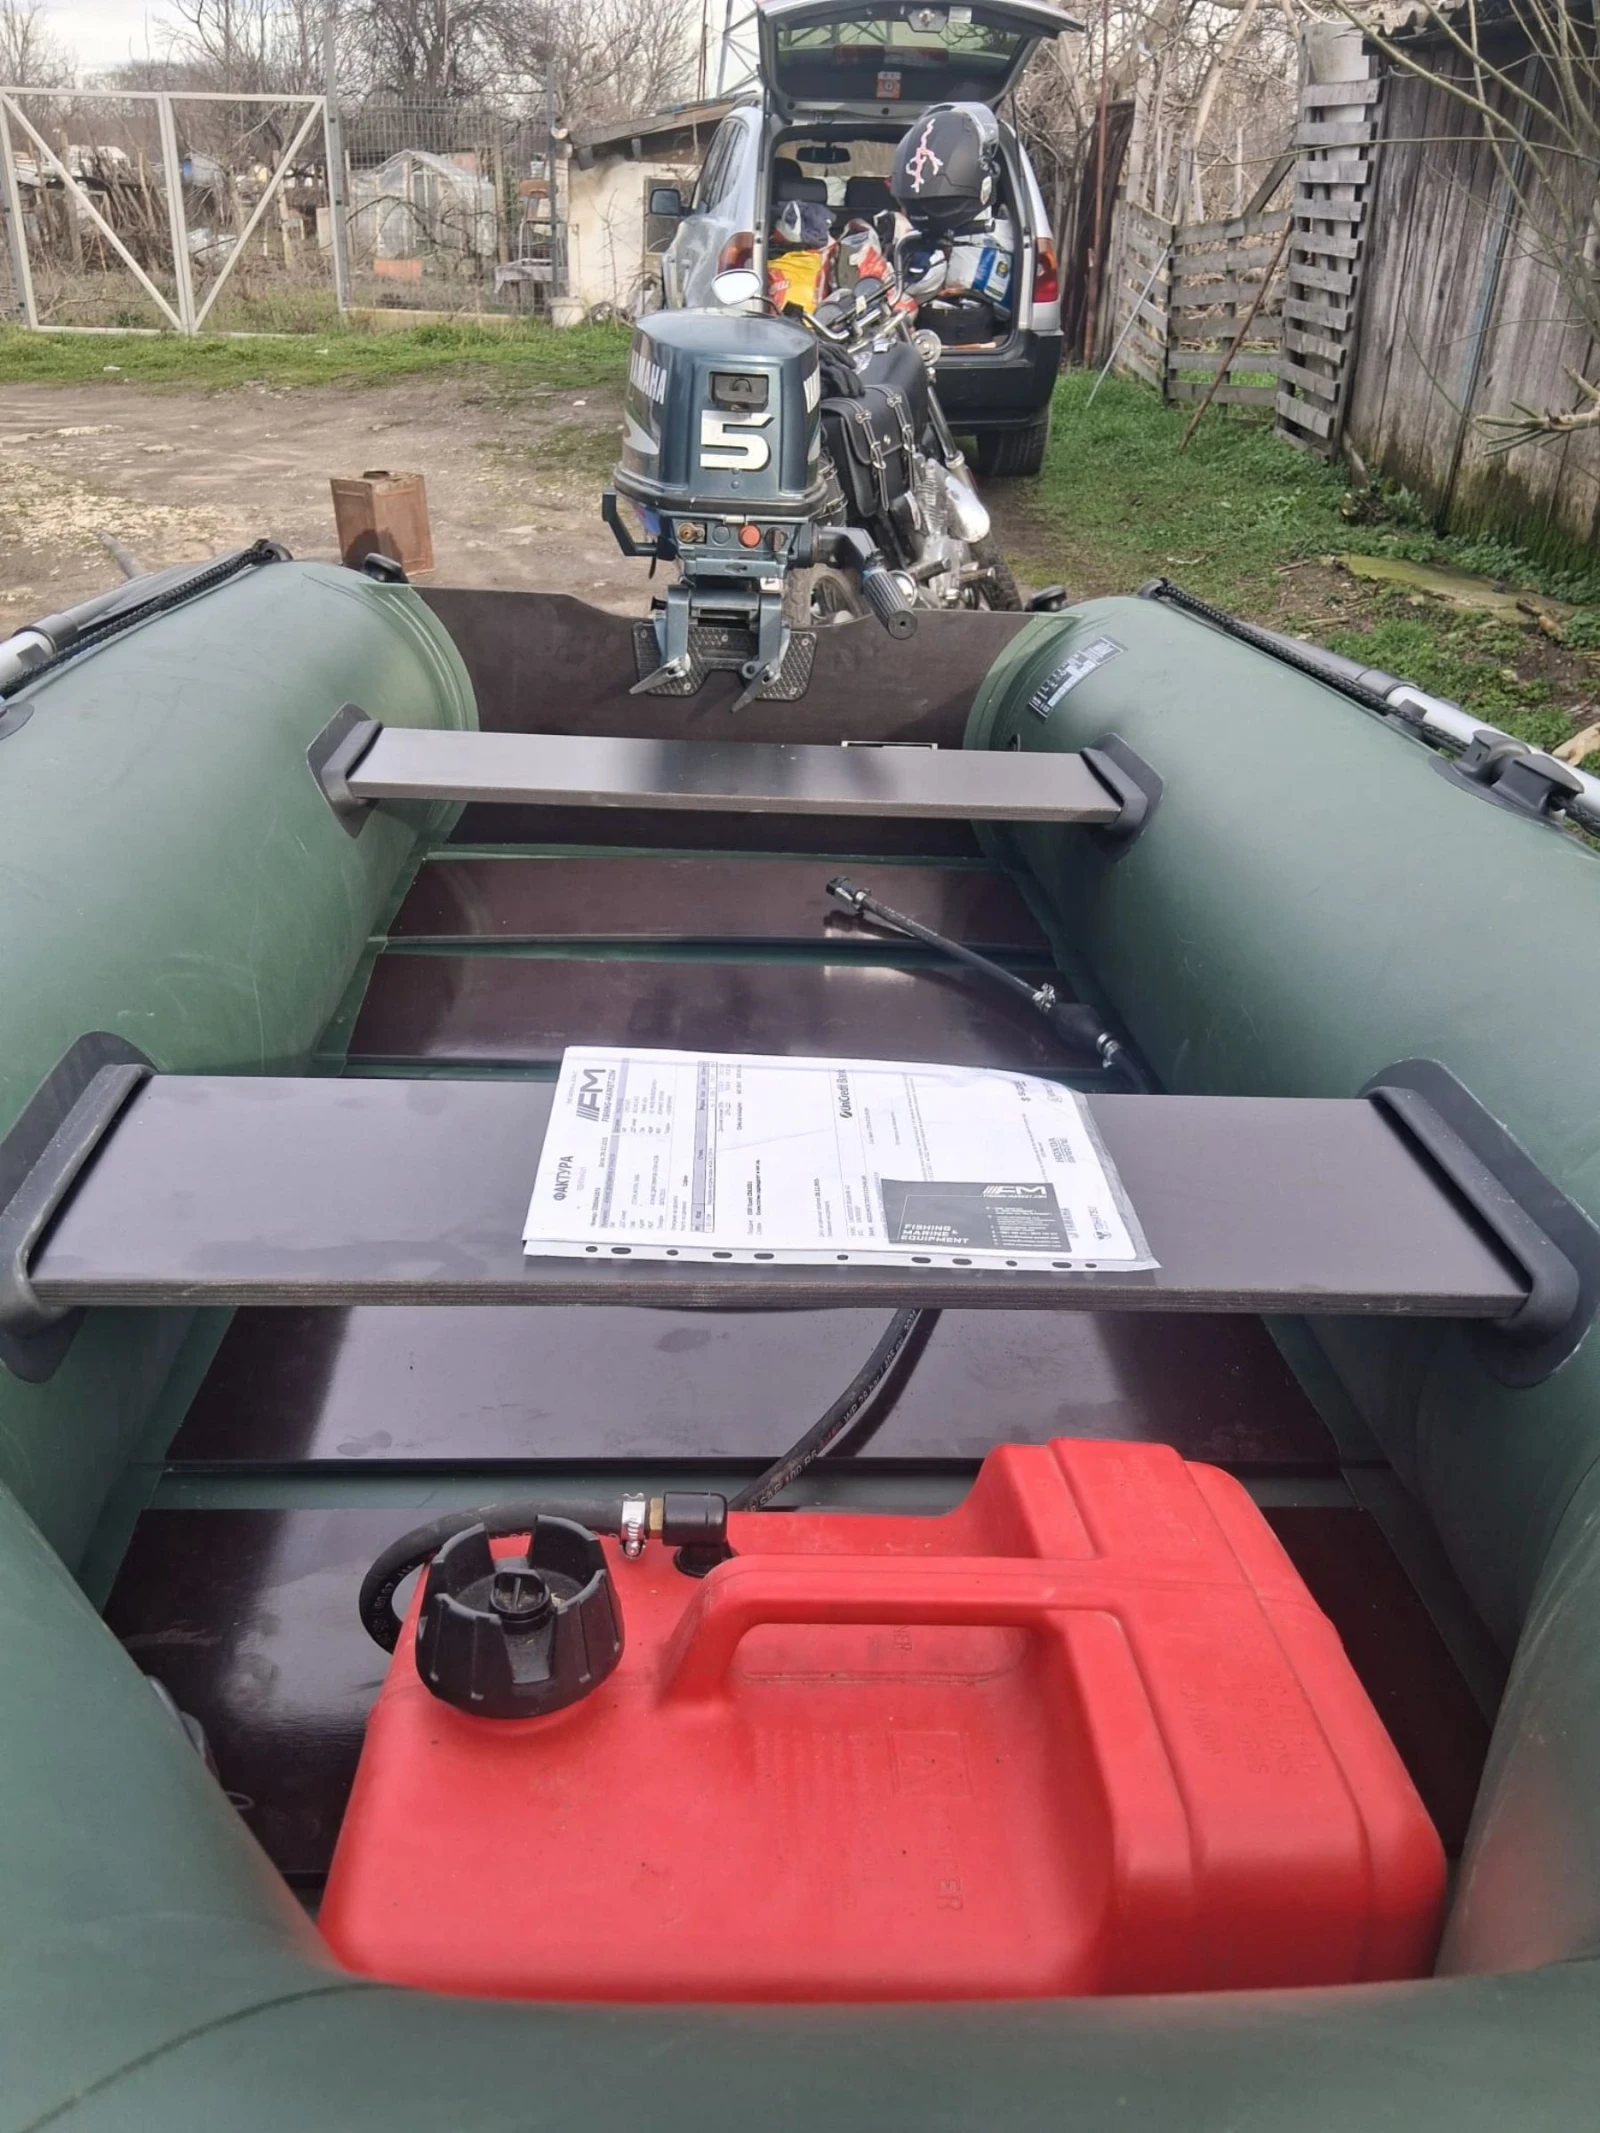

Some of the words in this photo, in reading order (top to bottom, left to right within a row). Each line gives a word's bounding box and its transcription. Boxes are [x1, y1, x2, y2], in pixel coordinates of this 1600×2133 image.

[700, 410, 774, 470] 5
[838, 1085, 852, 1111] UniCredit
[553, 1155, 574, 1201] ФАКТУРА
[901, 1235, 970, 1244] EQUIPMENT
[904, 1223, 952, 1231] FISHING
